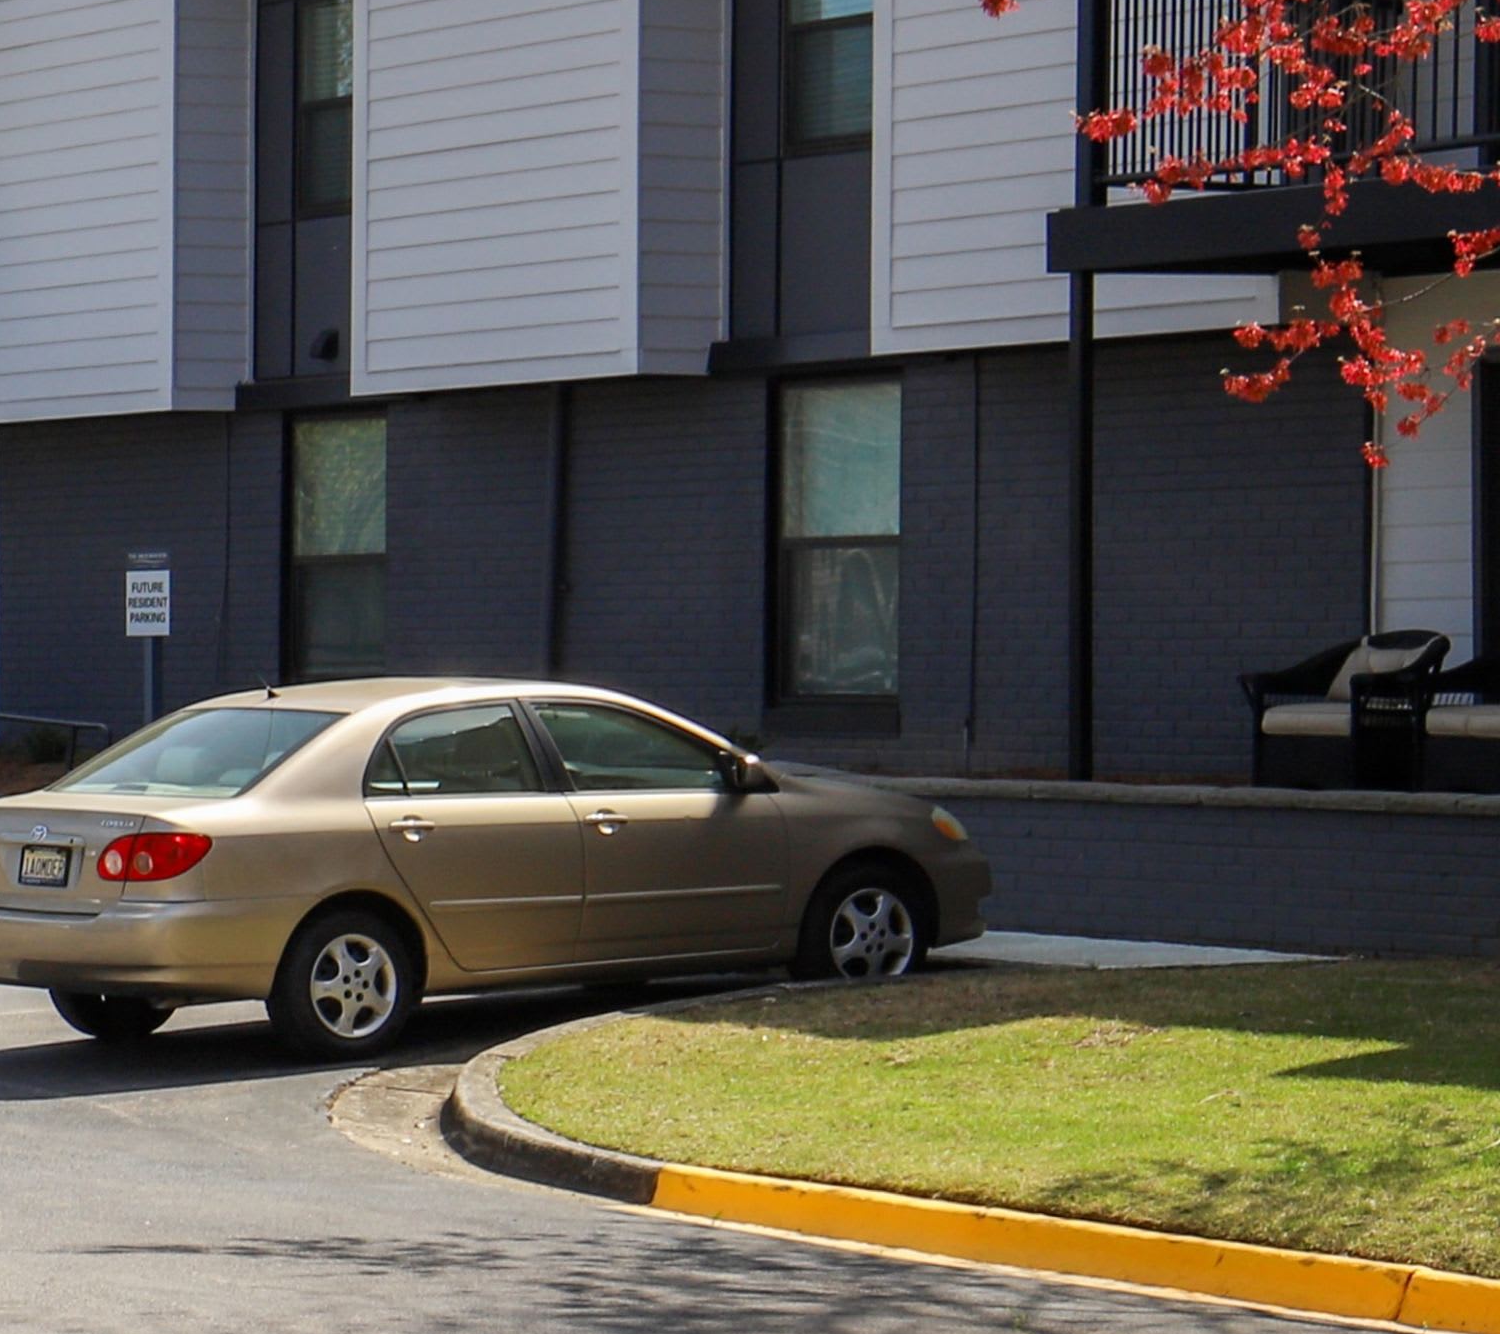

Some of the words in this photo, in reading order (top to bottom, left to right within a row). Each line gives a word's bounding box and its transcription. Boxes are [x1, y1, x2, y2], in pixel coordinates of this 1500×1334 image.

[131, 581, 164, 593] FUTURE
[128, 596, 168, 608] RESIDENT
[130, 611, 167, 624] PARKING
